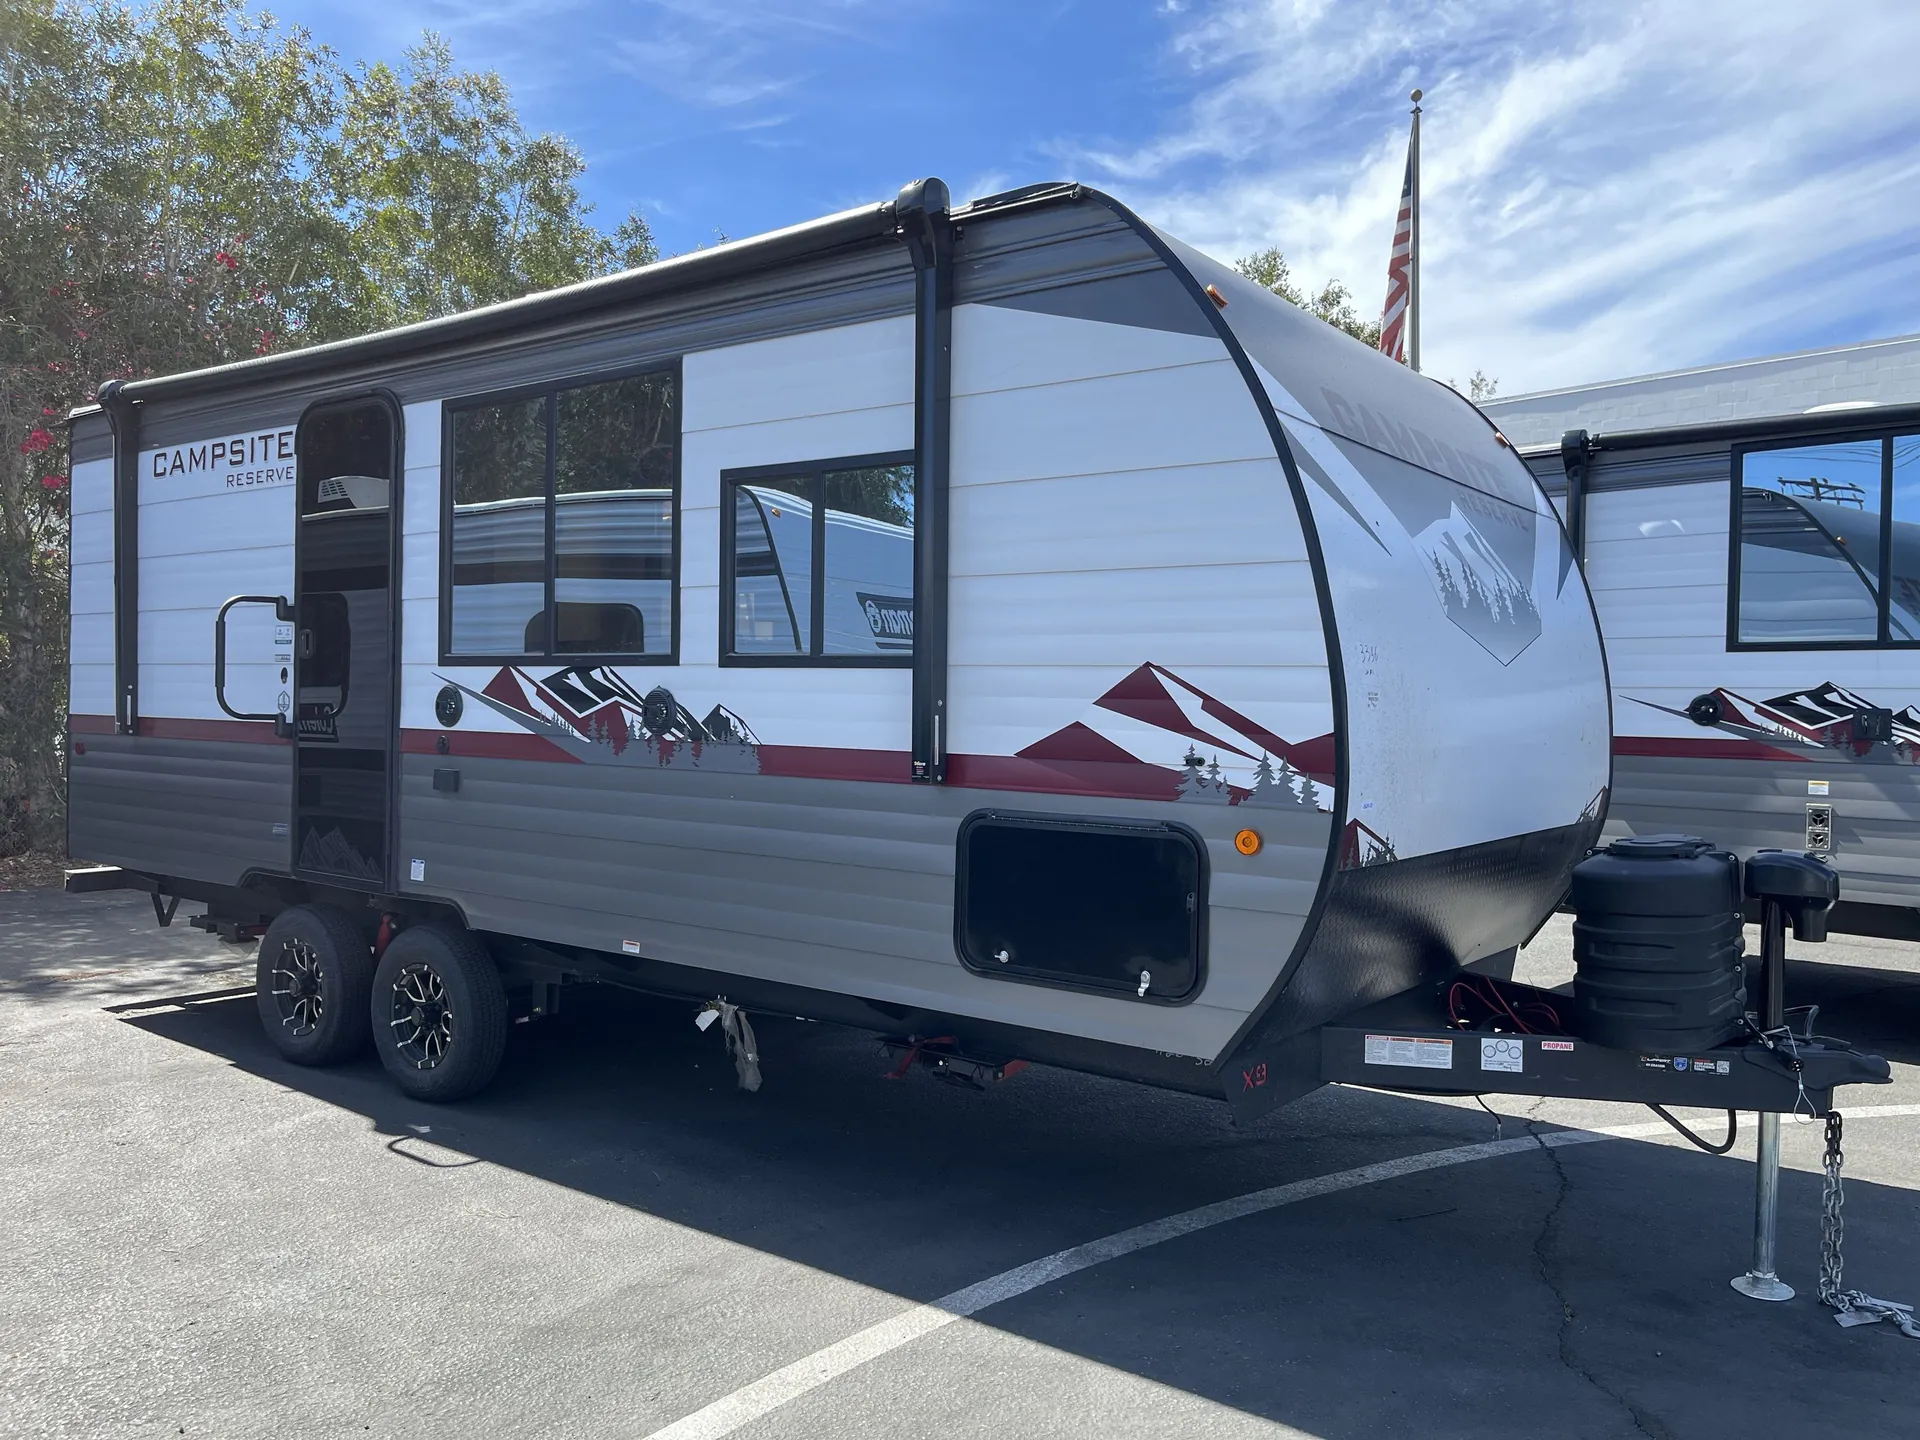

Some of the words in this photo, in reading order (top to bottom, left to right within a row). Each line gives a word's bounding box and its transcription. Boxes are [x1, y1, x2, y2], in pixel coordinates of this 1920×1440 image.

[152, 430, 294, 478] CAMPSITE
[226, 465, 294, 488] RESERVE
[1543, 1042, 1573, 1050] PROPANE
